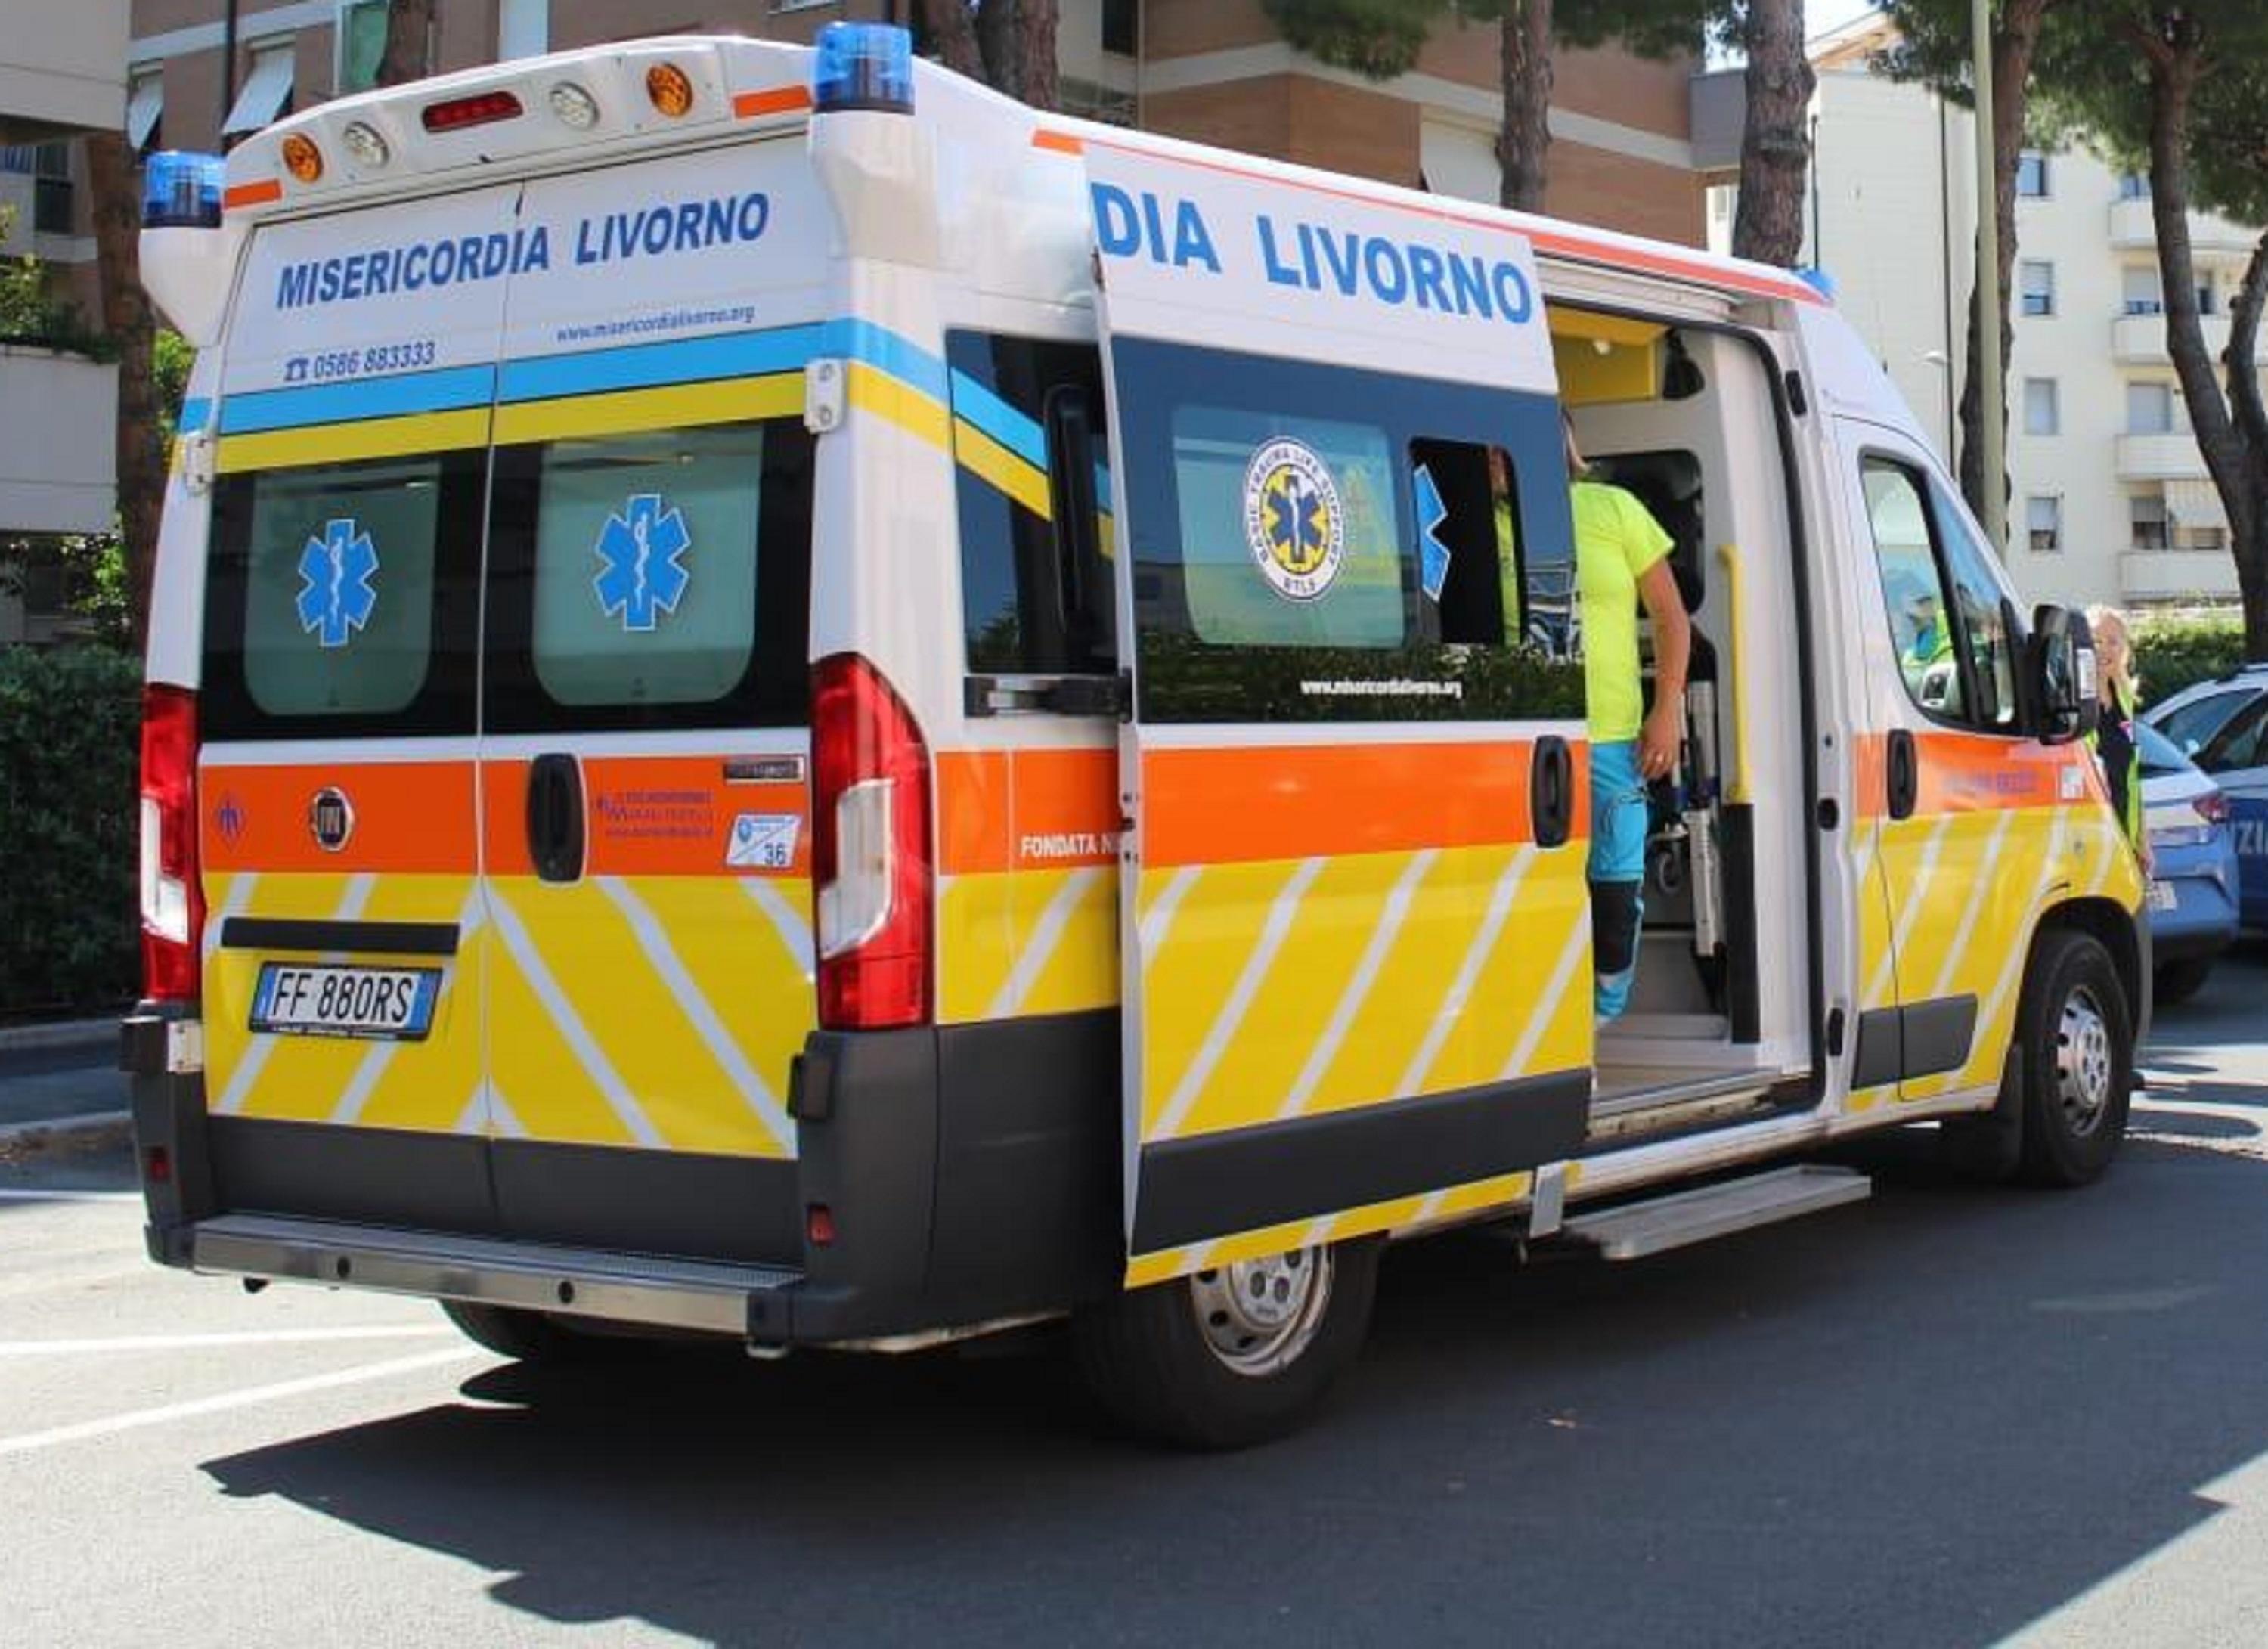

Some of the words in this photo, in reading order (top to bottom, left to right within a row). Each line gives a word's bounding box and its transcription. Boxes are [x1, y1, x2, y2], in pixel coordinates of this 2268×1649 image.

[276, 227, 550, 310] MISERICORDIA
[575, 192, 770, 265] LIVORNO
[1091, 181, 1221, 274] DIA
[1256, 215, 1531, 324] LIVORNO
[314, 350, 360, 378] 0586
[364, 341, 435, 372] 883333
[763, 842, 787, 866] 36
[1021, 832, 1097, 857] FONDATA
[273, 972, 313, 1017] FF
[317, 975, 413, 1023] 880RS
